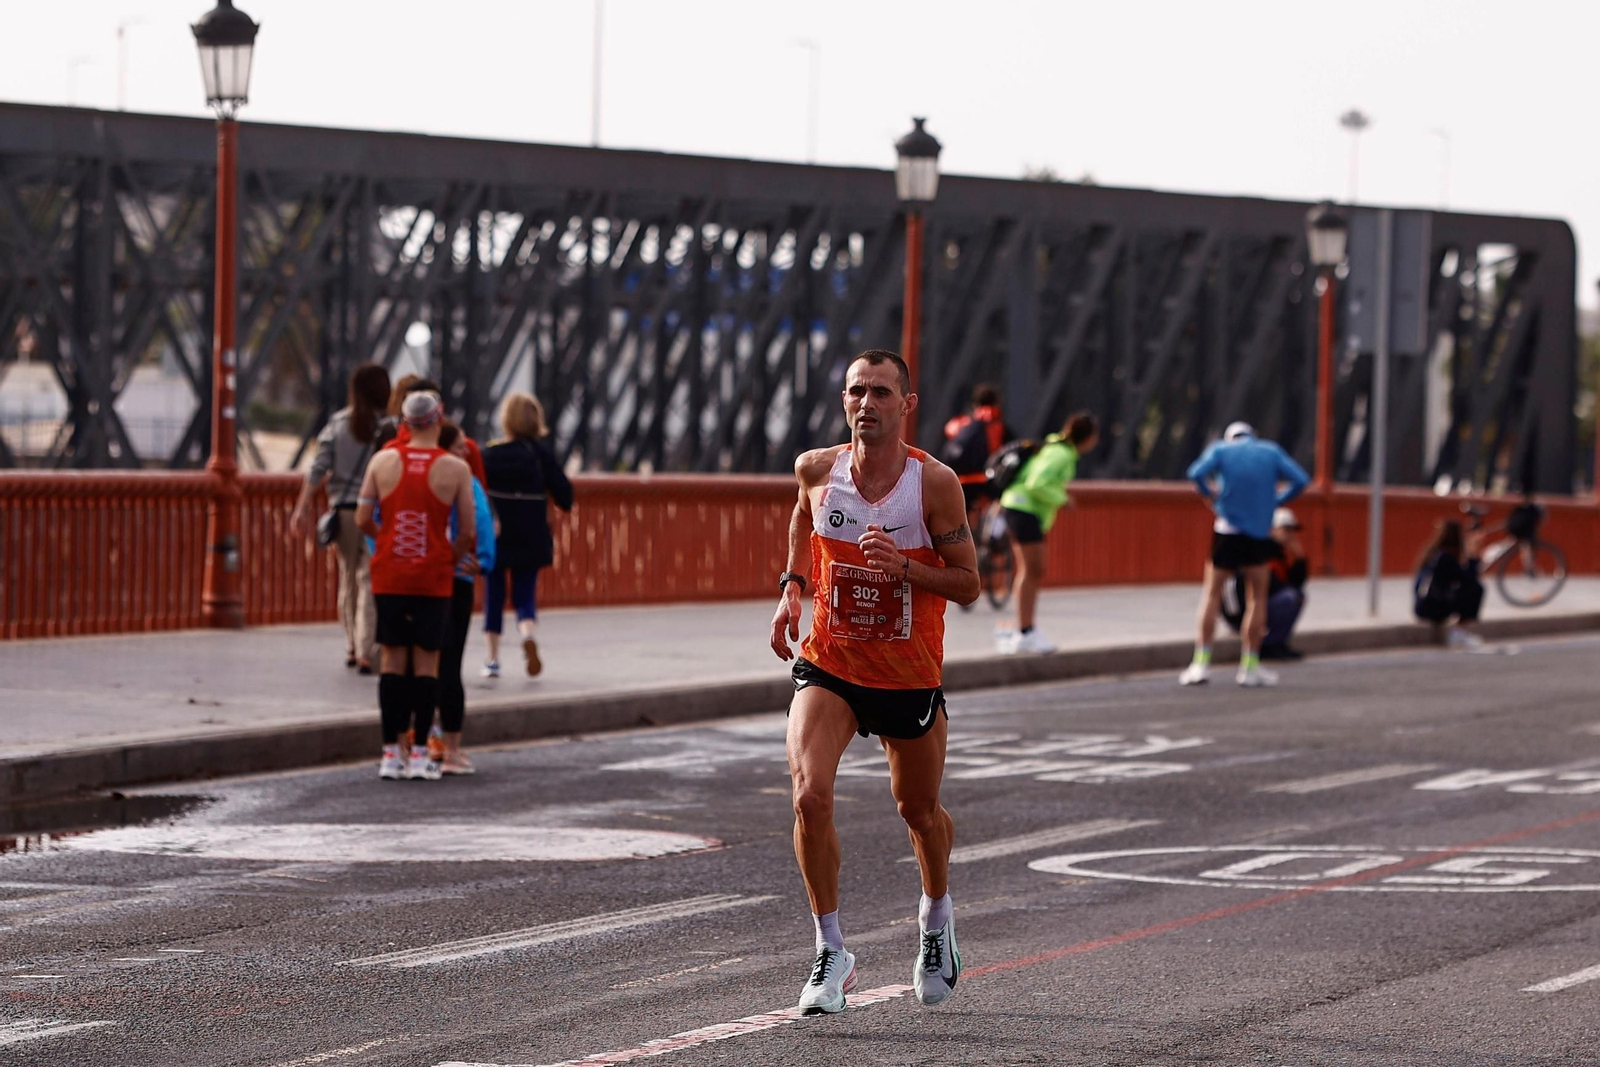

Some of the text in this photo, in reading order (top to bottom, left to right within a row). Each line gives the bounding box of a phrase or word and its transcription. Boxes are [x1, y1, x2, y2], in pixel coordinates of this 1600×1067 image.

[852, 585, 880, 602] 302
[856, 601, 876, 609] BENOIT
[1198, 853, 1592, 886] 50
